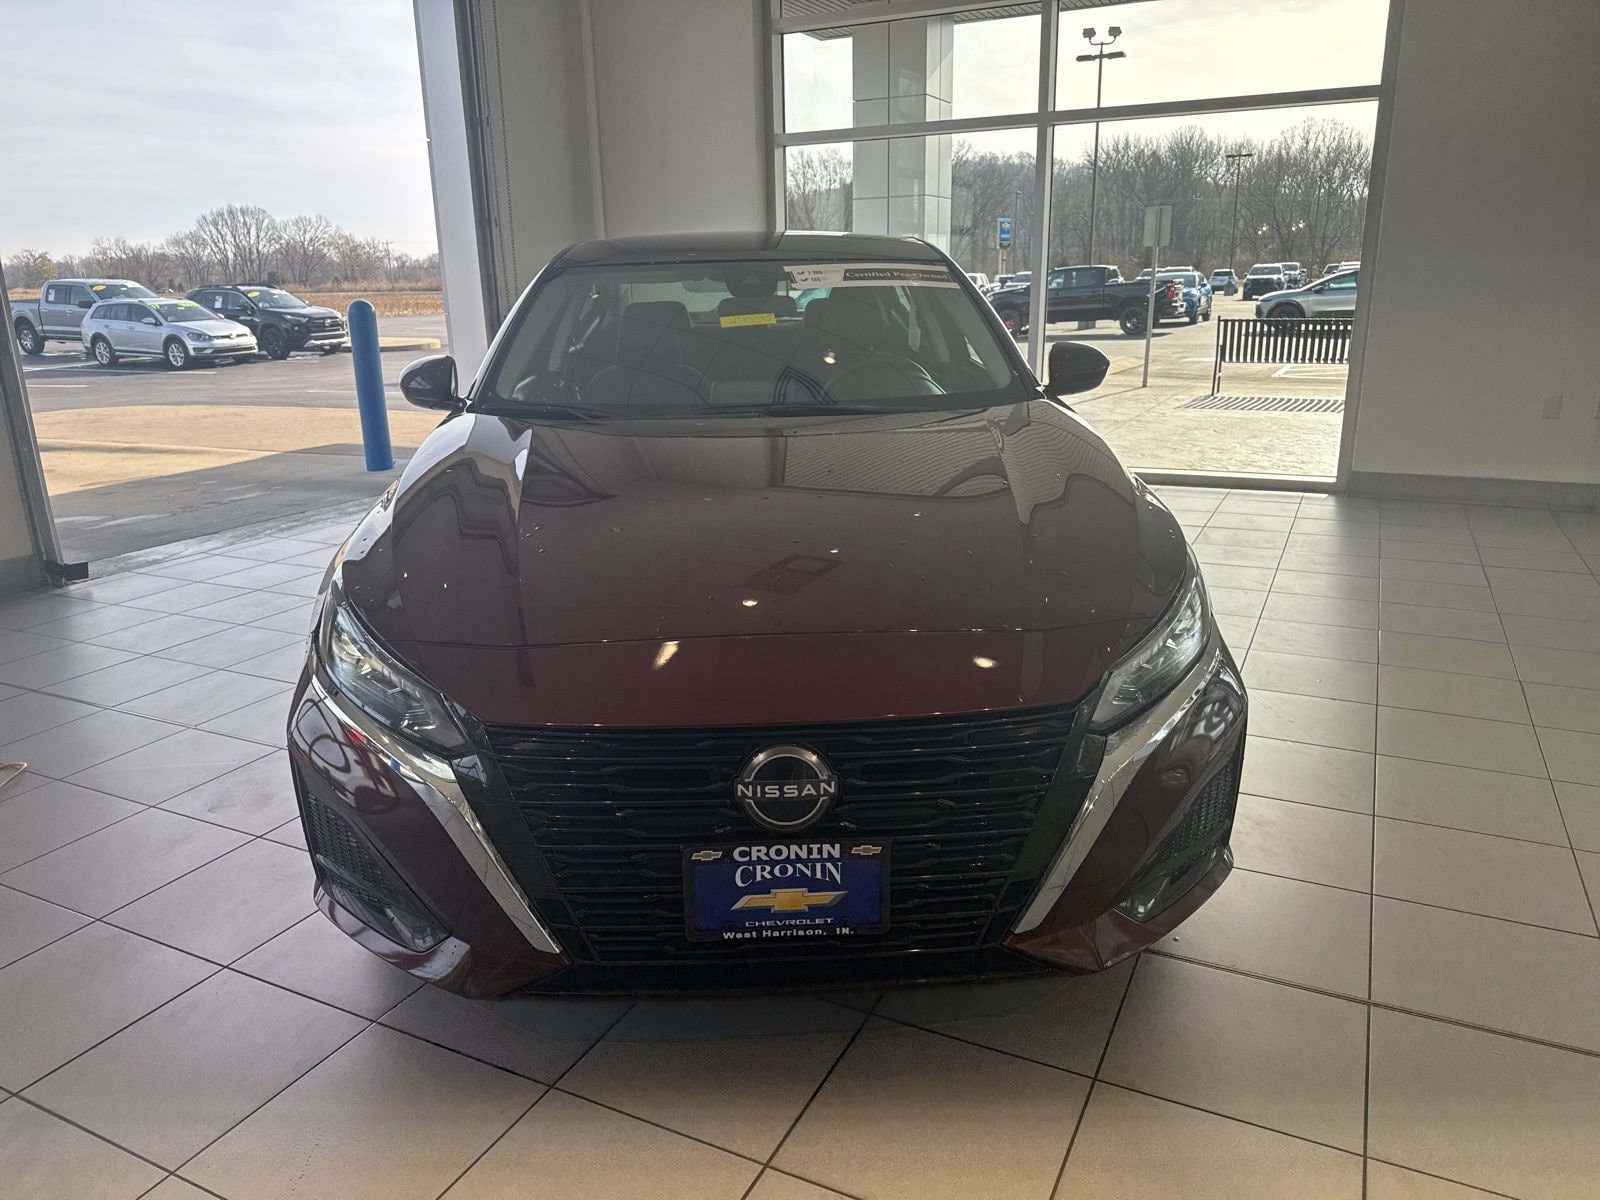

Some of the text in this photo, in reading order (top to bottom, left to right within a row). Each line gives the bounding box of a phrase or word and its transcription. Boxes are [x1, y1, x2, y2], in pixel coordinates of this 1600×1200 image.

[737, 782, 835, 798] NISSAN
[733, 844, 841, 862] CRONIN
[735, 862, 843, 887] CRONIN
[745, 918, 834, 927] CHEVROLET
[723, 931, 757, 939] West
[836, 927, 854, 935] IN.
